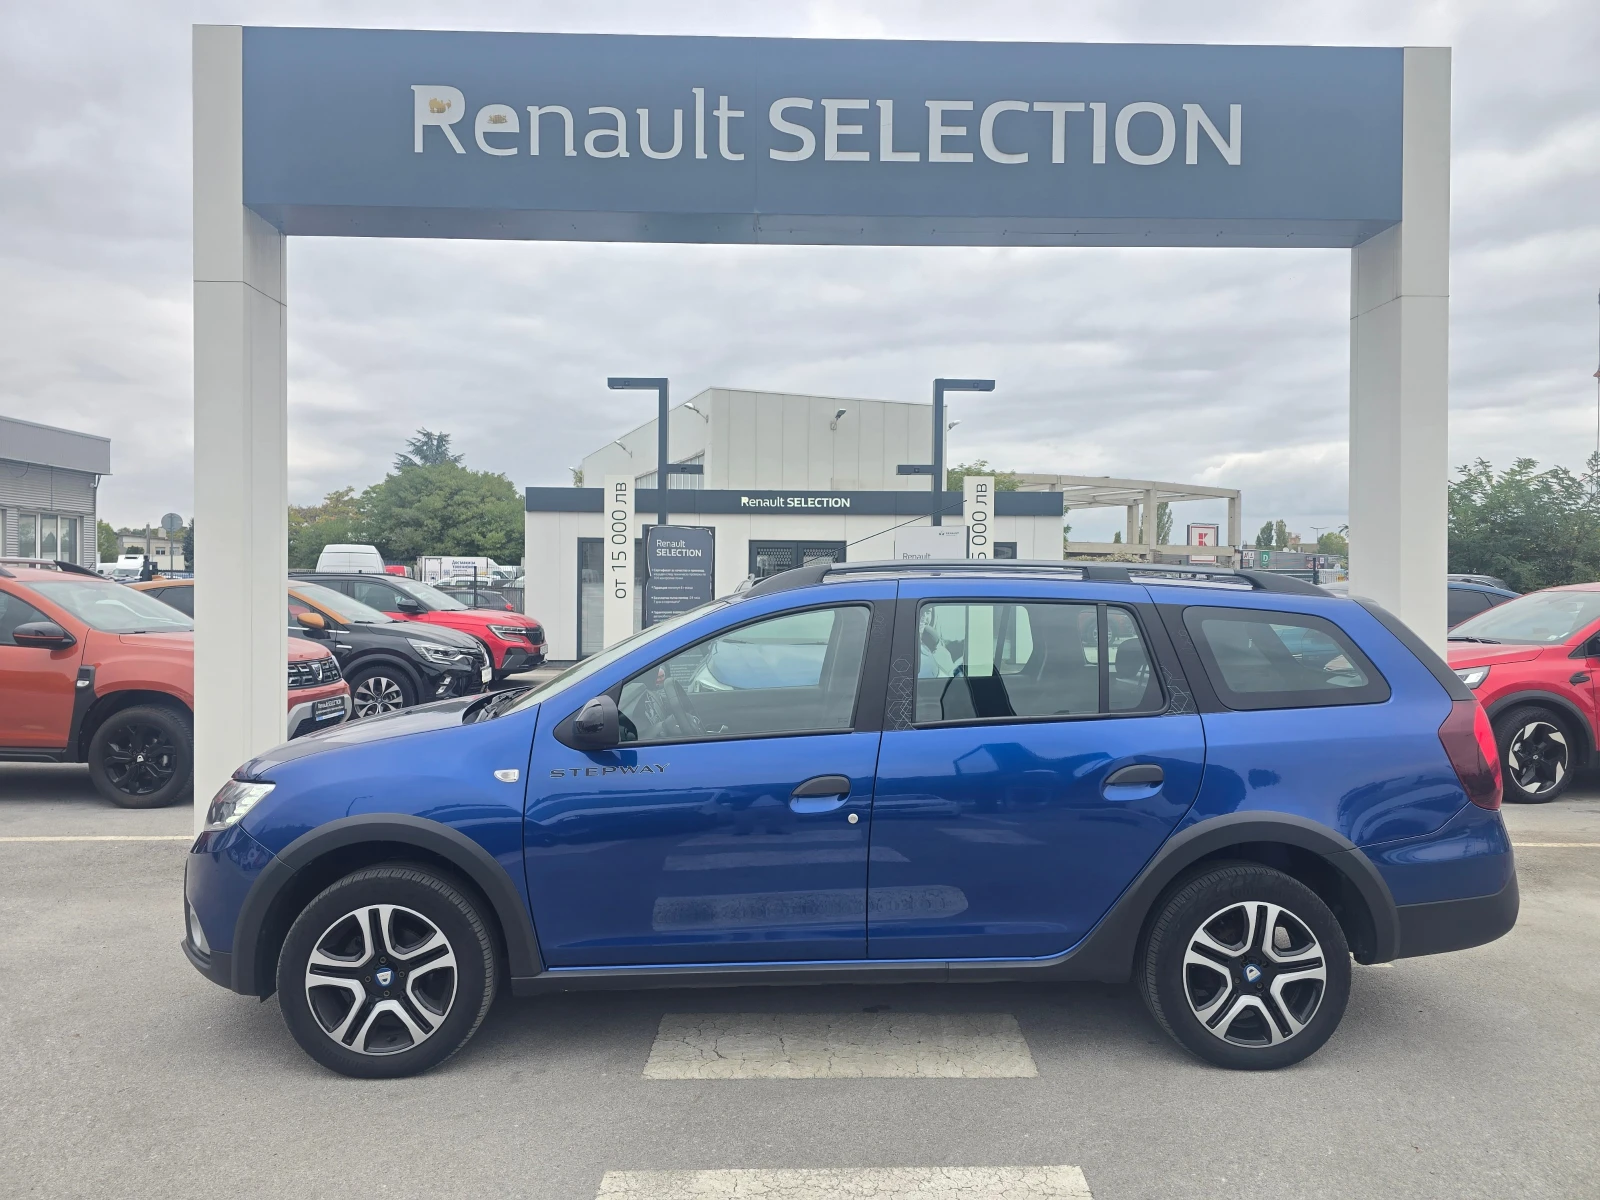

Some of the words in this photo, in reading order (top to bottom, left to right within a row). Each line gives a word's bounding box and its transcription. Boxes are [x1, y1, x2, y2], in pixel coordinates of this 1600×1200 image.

[410, 84, 745, 161] Renault
[768, 97, 1242, 166] SELECTION
[740, 496, 785, 507] Renault
[786, 497, 851, 508] SELECTION
[611, 509, 627, 545] 000
[971, 510, 987, 546] 000
[656, 539, 686, 548] Renault
[656, 548, 702, 557] SELECTION
[611, 551, 627, 572] 15
[550, 763, 670, 778] STEPWAY
